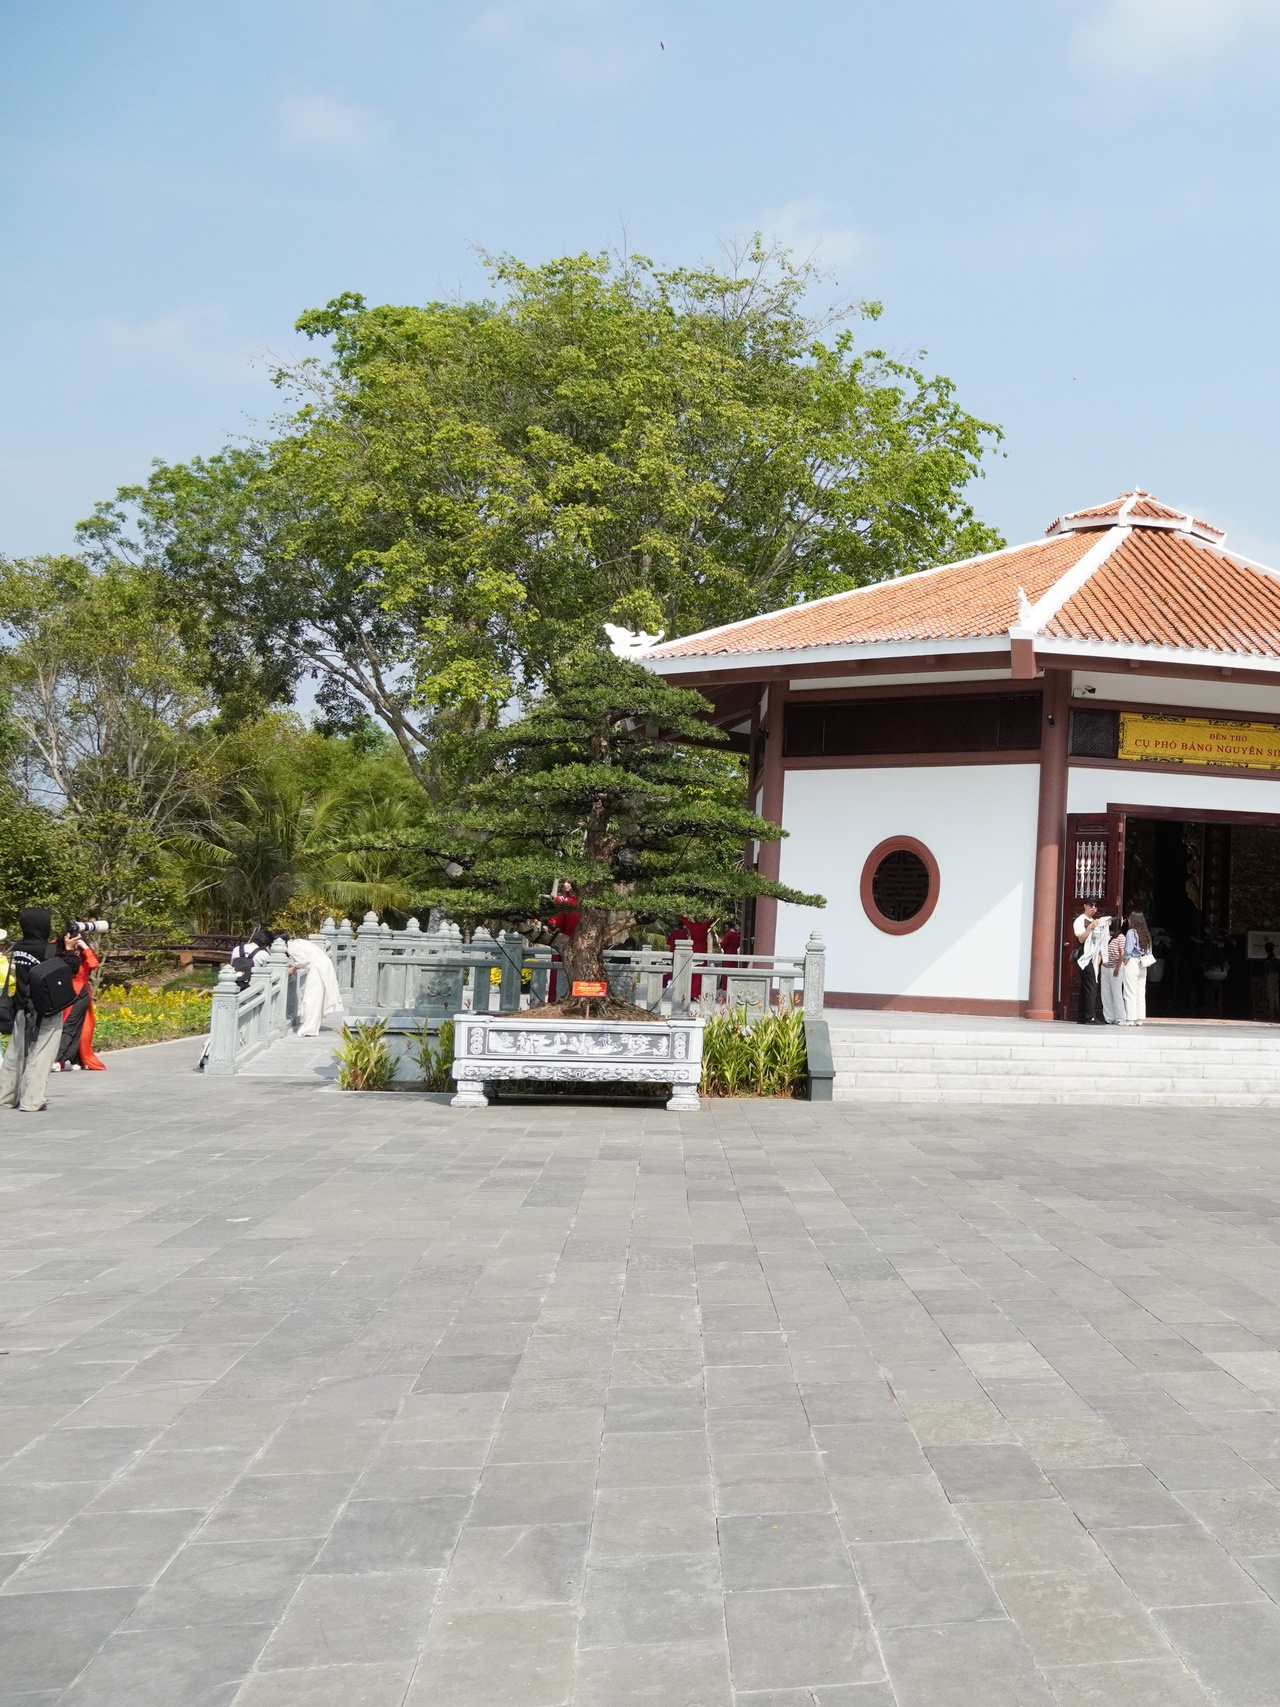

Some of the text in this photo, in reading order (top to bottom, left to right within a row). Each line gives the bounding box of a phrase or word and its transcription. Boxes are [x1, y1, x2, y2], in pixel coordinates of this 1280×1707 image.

[1134, 738, 1150, 749] CỤ
[1154, 739, 1177, 750] PHÓ
[1181, 740, 1213, 752] BẢNG
